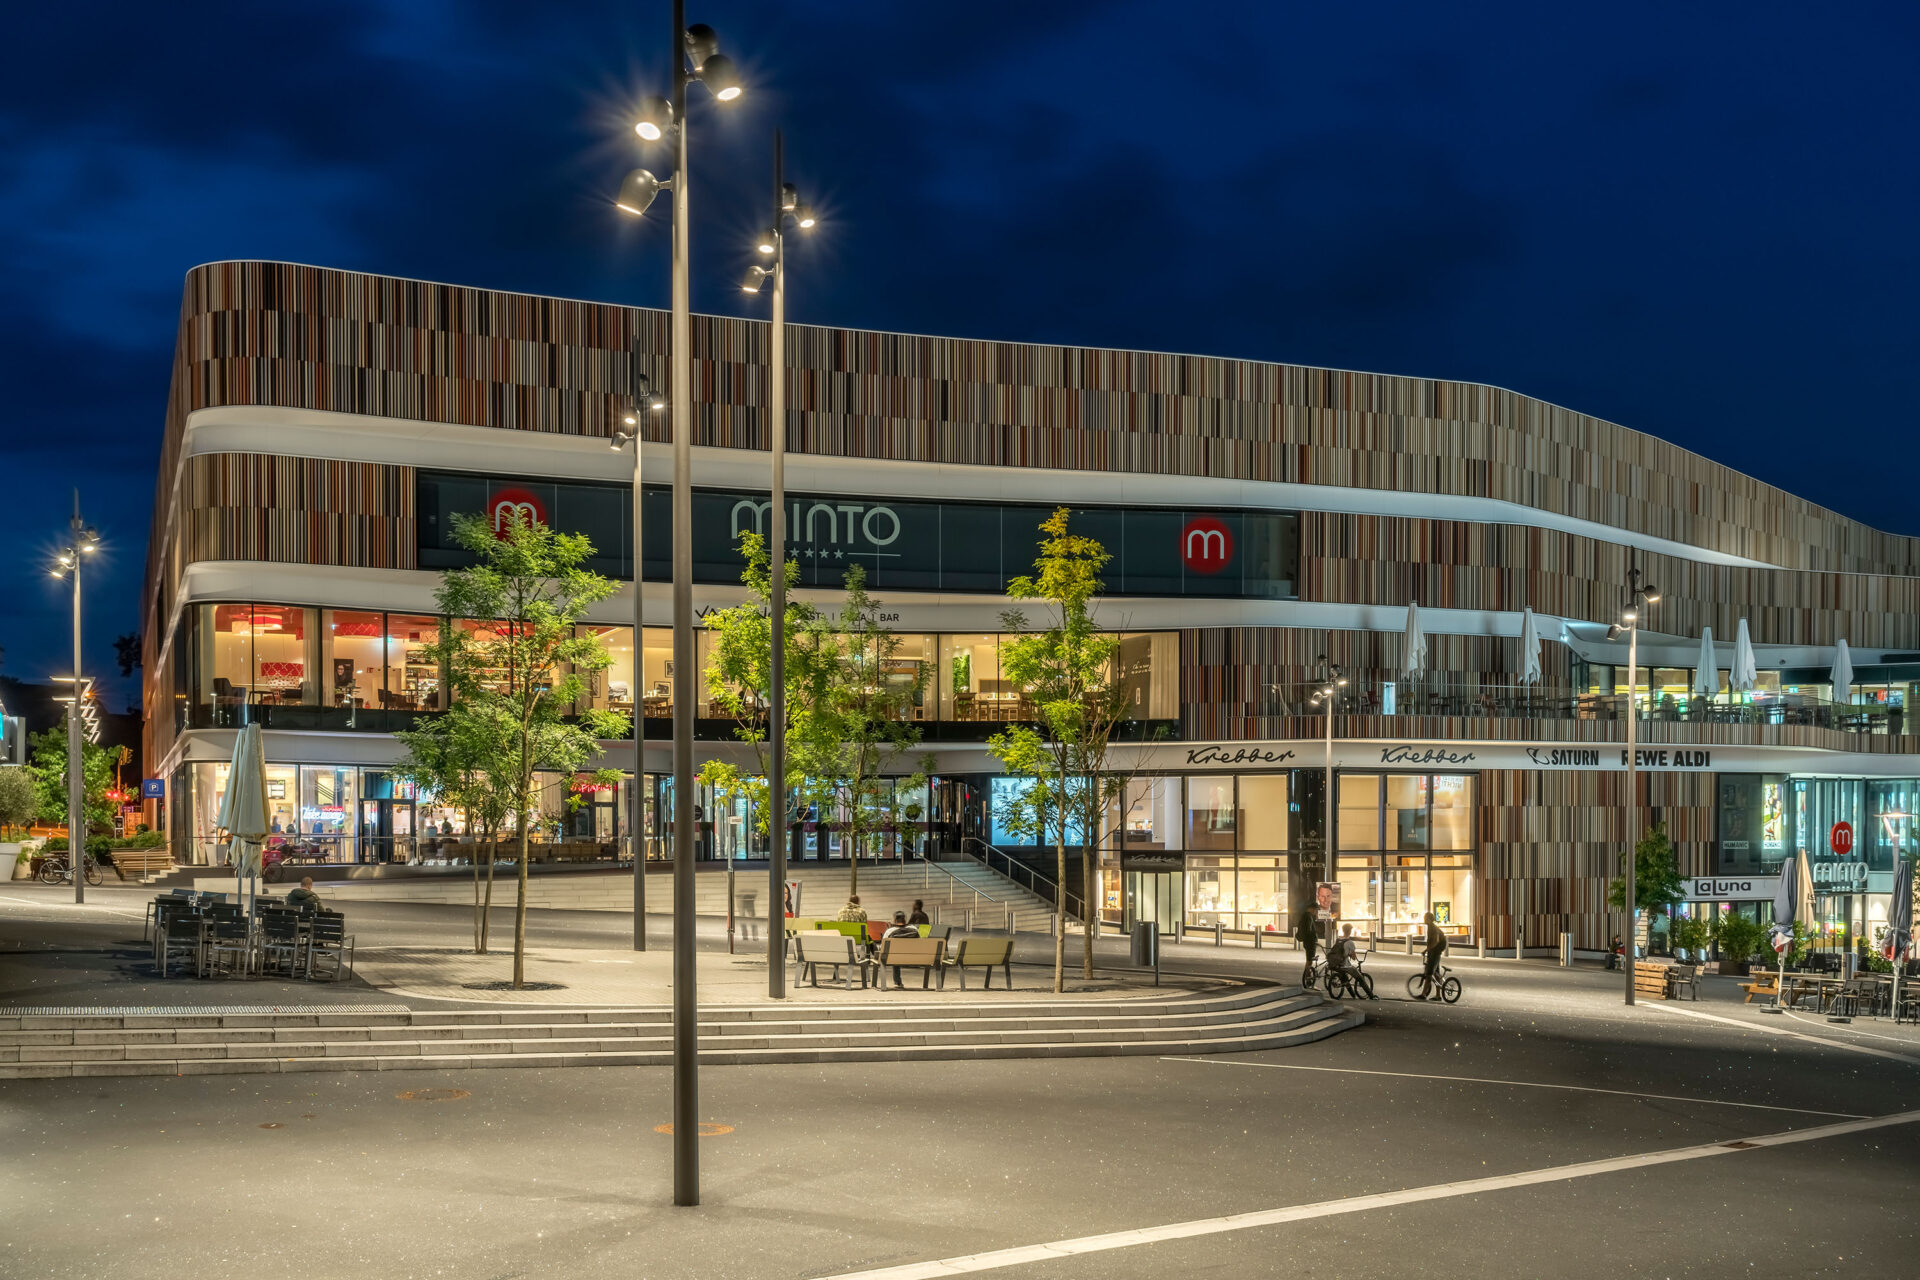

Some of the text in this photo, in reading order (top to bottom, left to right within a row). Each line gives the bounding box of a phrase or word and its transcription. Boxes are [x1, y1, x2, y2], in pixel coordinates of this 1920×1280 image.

[880, 613, 900, 621] BAR
[1187, 746, 1295, 764] Krebber
[1380, 745, 1476, 764] Krebber
[1551, 750, 1599, 766] SATURN
[1621, 750, 1710, 767] REWE ALDI
[1723, 841, 1748, 849] HUMANIC
[1695, 879, 1752, 896] LaLuna
